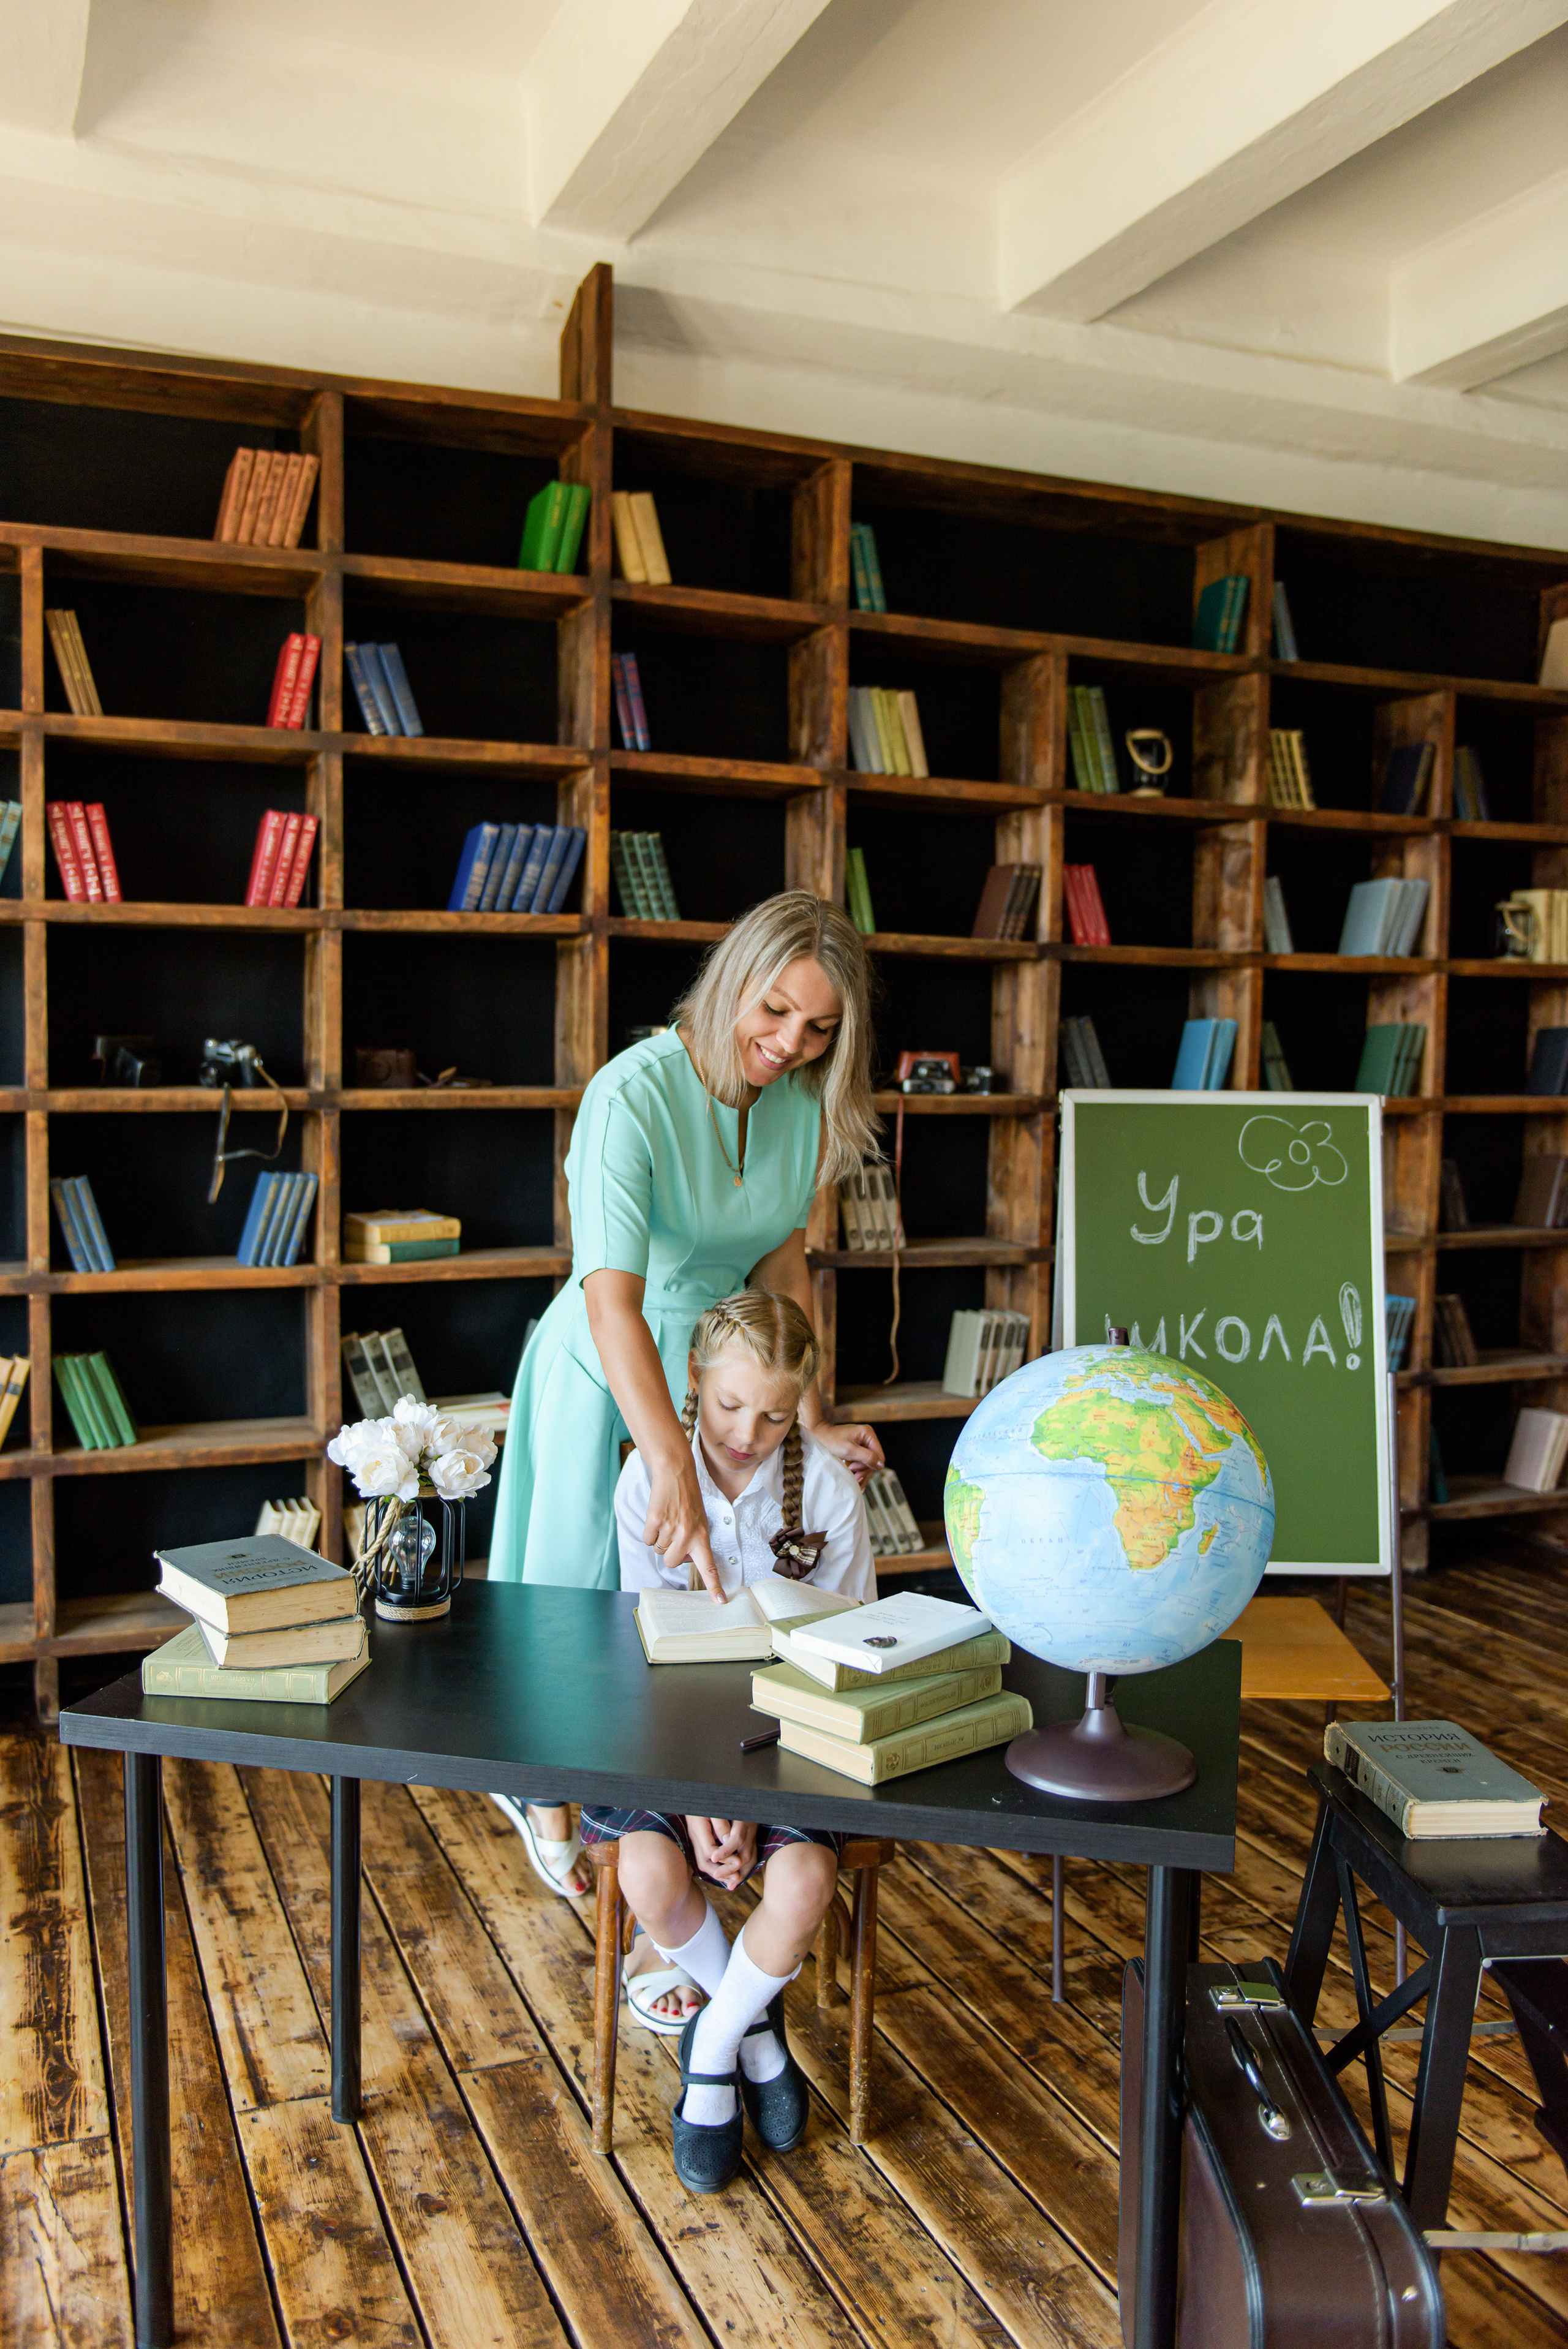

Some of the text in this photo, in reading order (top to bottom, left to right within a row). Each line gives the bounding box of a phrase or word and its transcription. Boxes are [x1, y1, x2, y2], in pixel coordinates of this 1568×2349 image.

[1129, 1171, 1264, 1265] Ура
[214, 1560, 308, 1580] РОССИИ
[222, 1564, 318, 1585] ИСТОРИЯ
[1368, 1733, 1461, 1743] ИСТОРИЯ
[1380, 1743, 1472, 1753] РОССИИ
